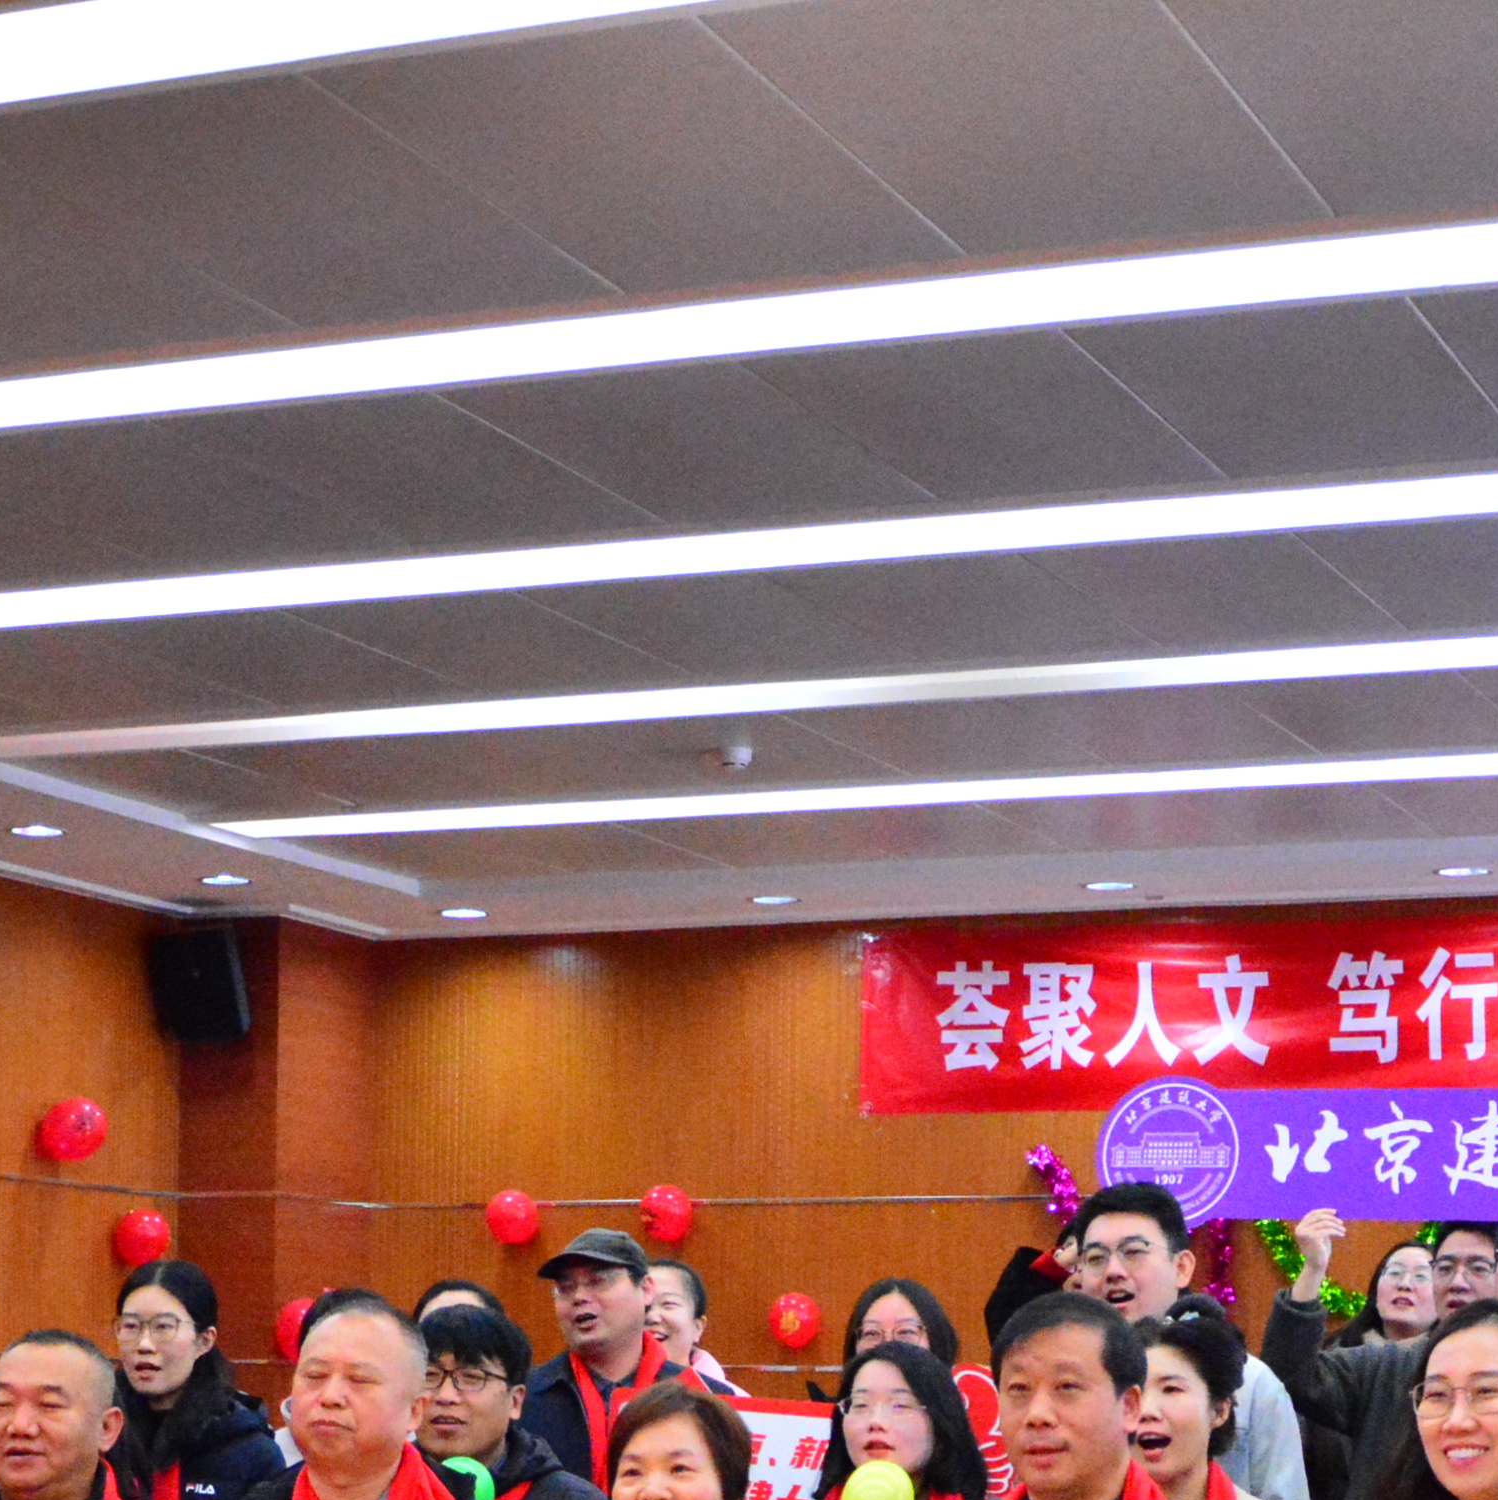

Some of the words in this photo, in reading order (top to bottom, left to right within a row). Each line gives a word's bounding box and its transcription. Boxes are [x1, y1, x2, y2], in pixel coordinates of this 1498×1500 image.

[935, 954, 1270, 1072] 荟聚人文
[1124, 1089, 1224, 1125] 北京建筑大学
[1154, 1173, 1184, 1185] 1907
[185, 1482, 216, 1495] FILA
